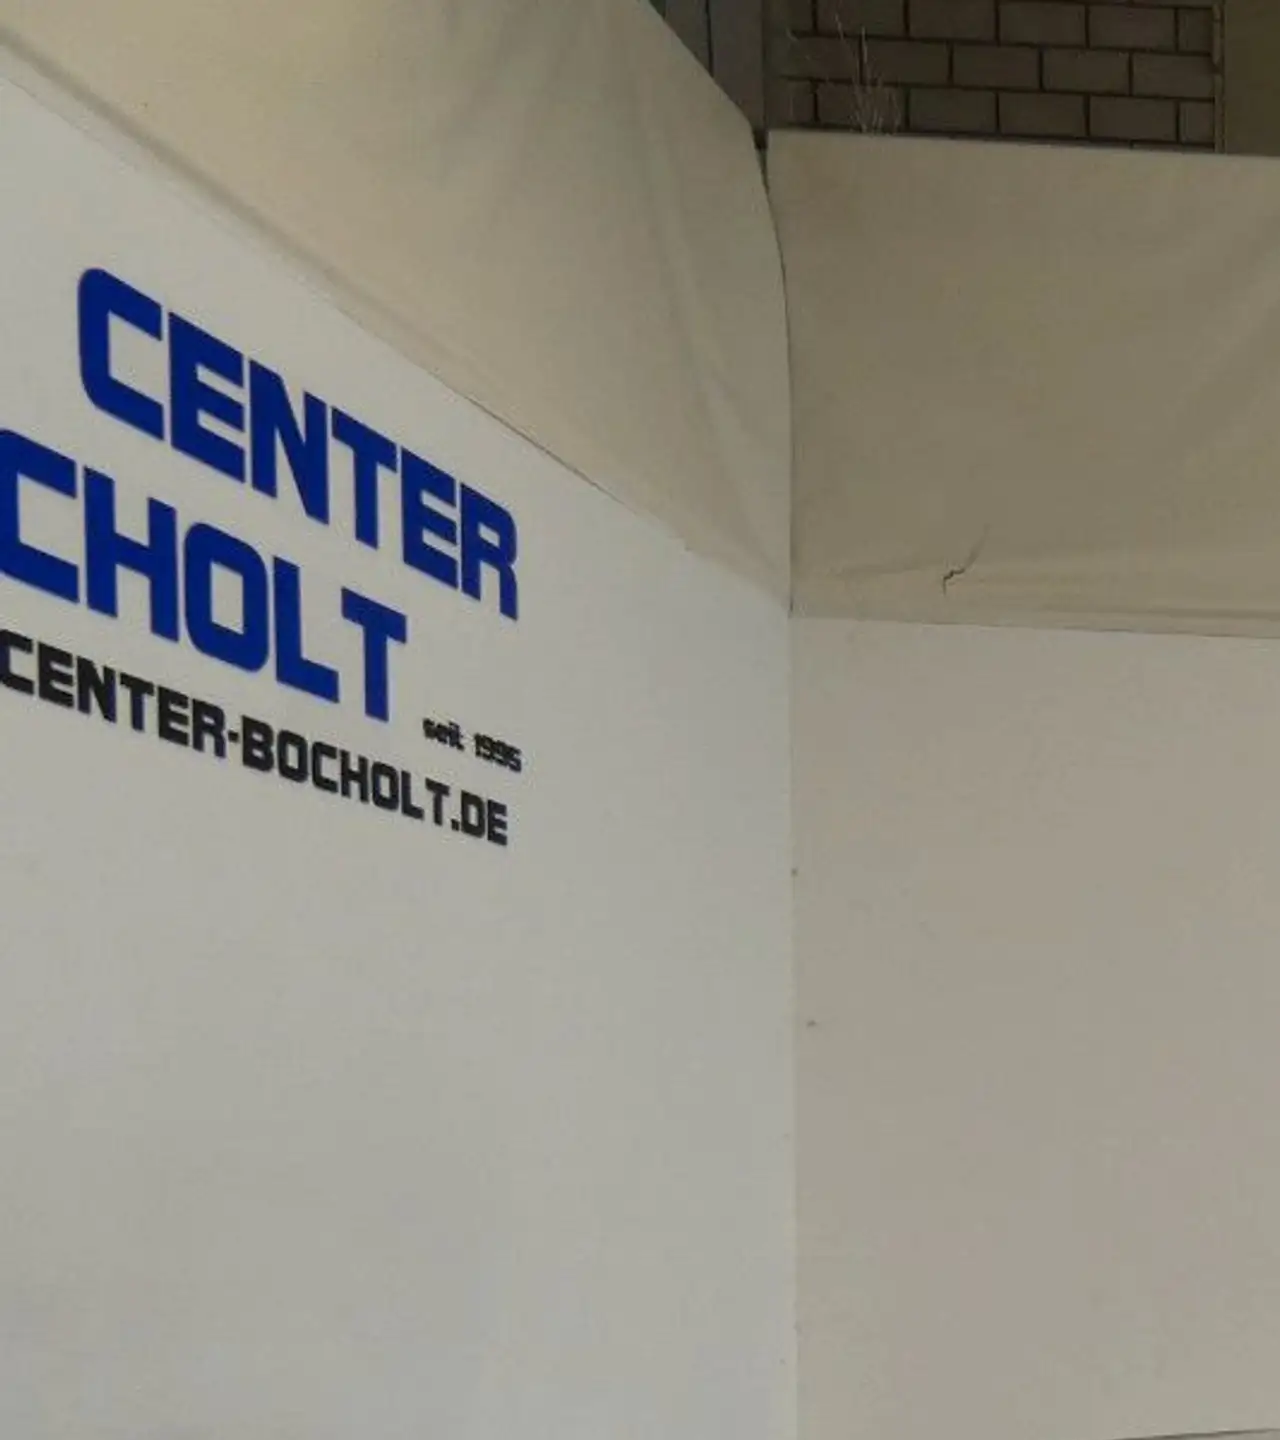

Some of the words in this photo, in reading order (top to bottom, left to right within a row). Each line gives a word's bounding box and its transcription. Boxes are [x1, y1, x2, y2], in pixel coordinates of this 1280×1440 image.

[0, 429, 408, 723] CHOLT
[77, 268, 518, 622] CENTER
[422, 717, 465, 752] seit
[473, 732, 523, 774] 1995
